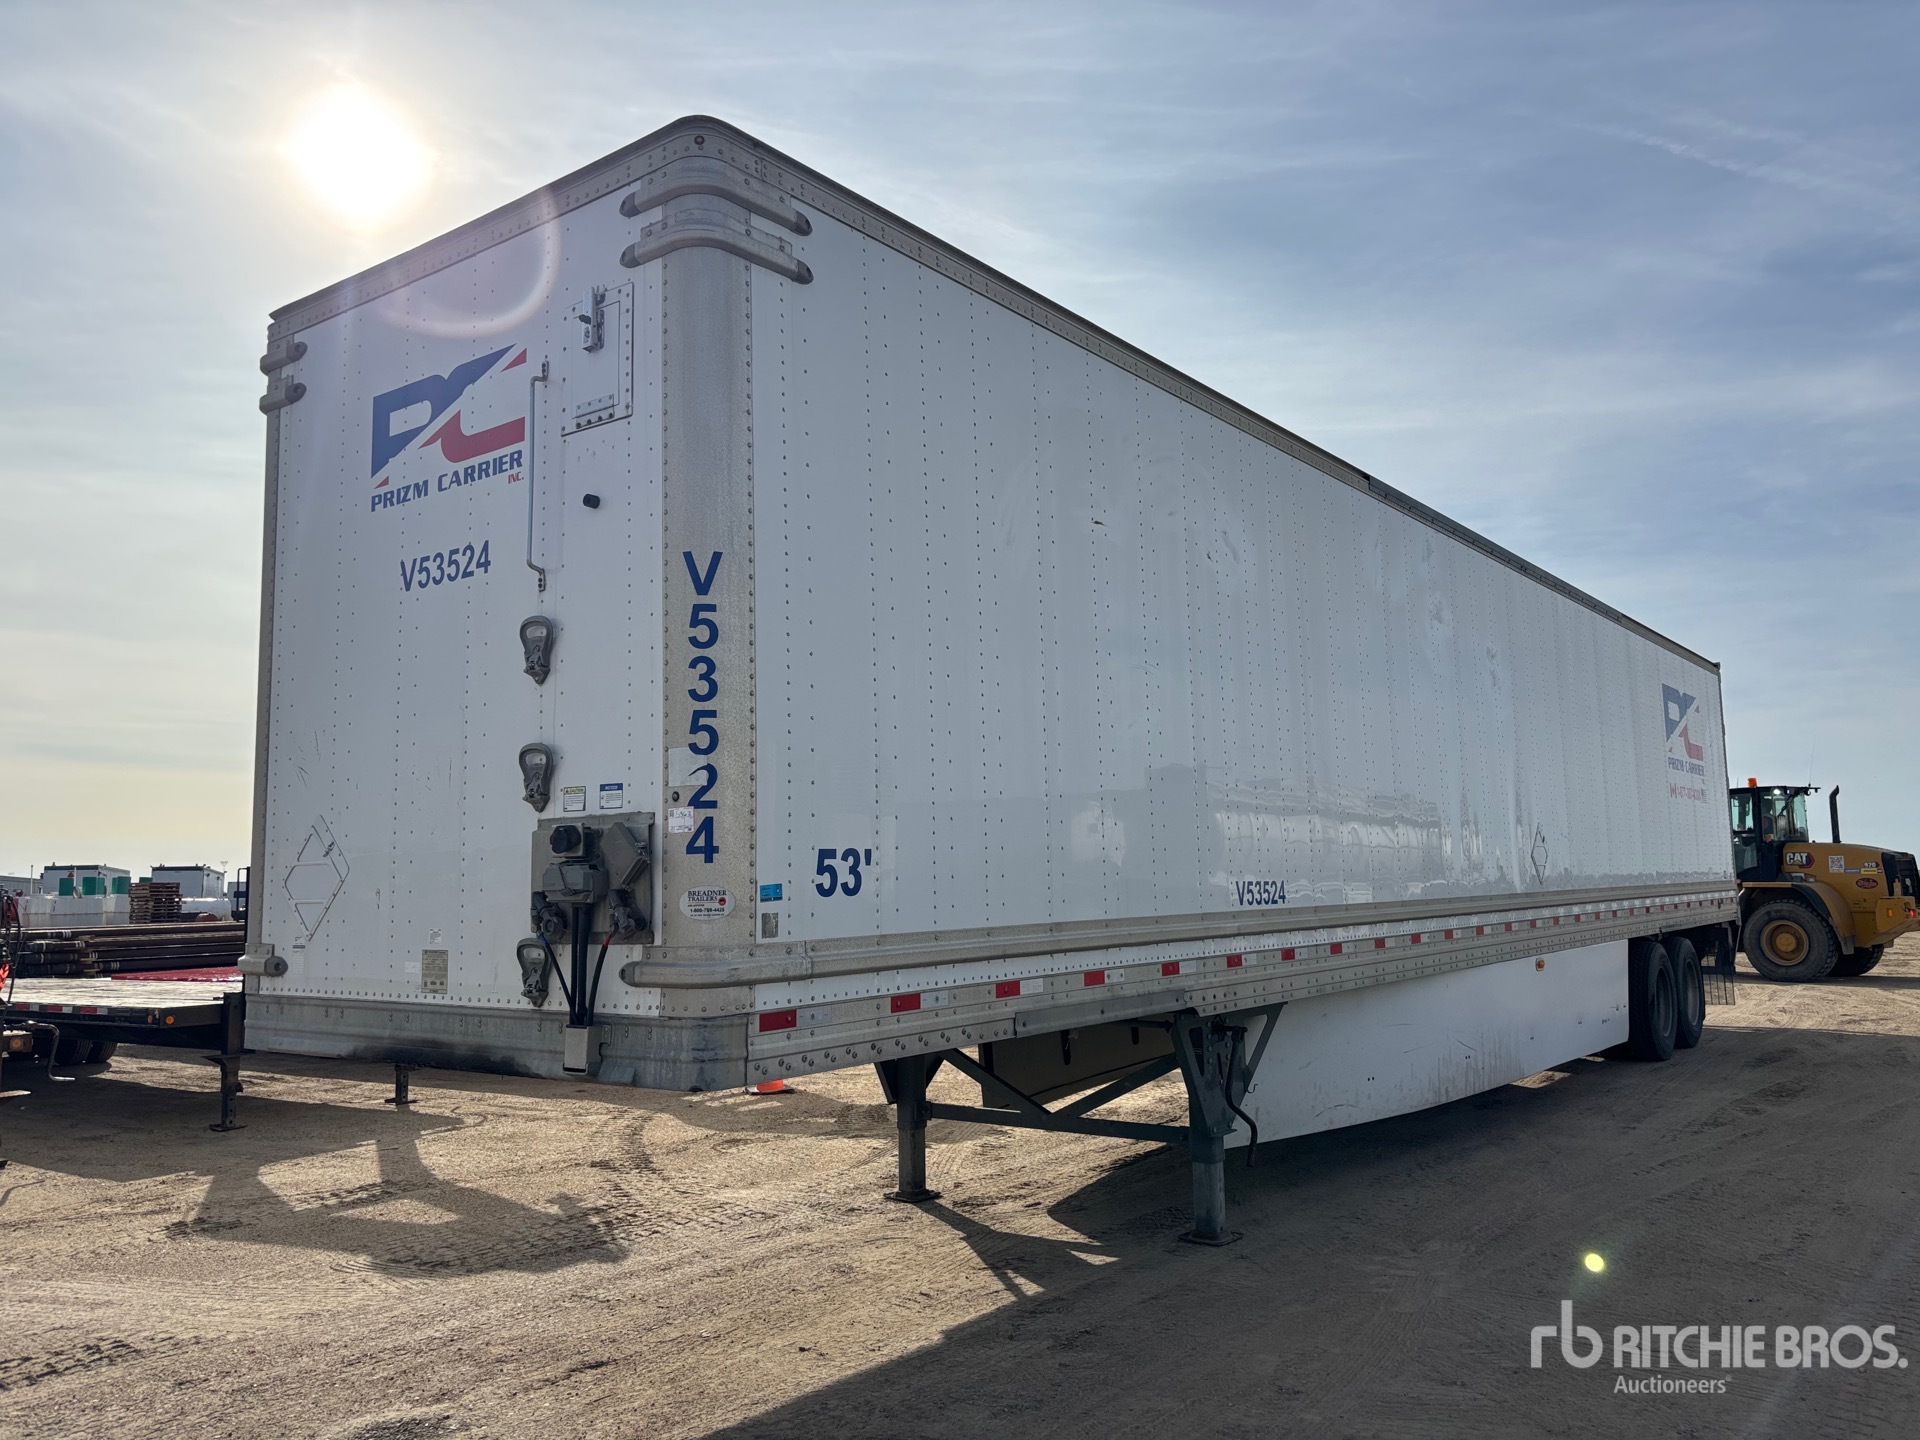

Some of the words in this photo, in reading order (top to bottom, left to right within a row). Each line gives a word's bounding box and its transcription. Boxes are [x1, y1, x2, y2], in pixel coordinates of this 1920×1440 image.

[371, 479, 429, 512] PRIZM
[437, 449, 523, 493] CARRIER
[401, 540, 491, 592] V53524
[815, 848, 872, 898] 53'
[1786, 852, 1808, 866] CAT
[1236, 880, 1286, 906] V53524
